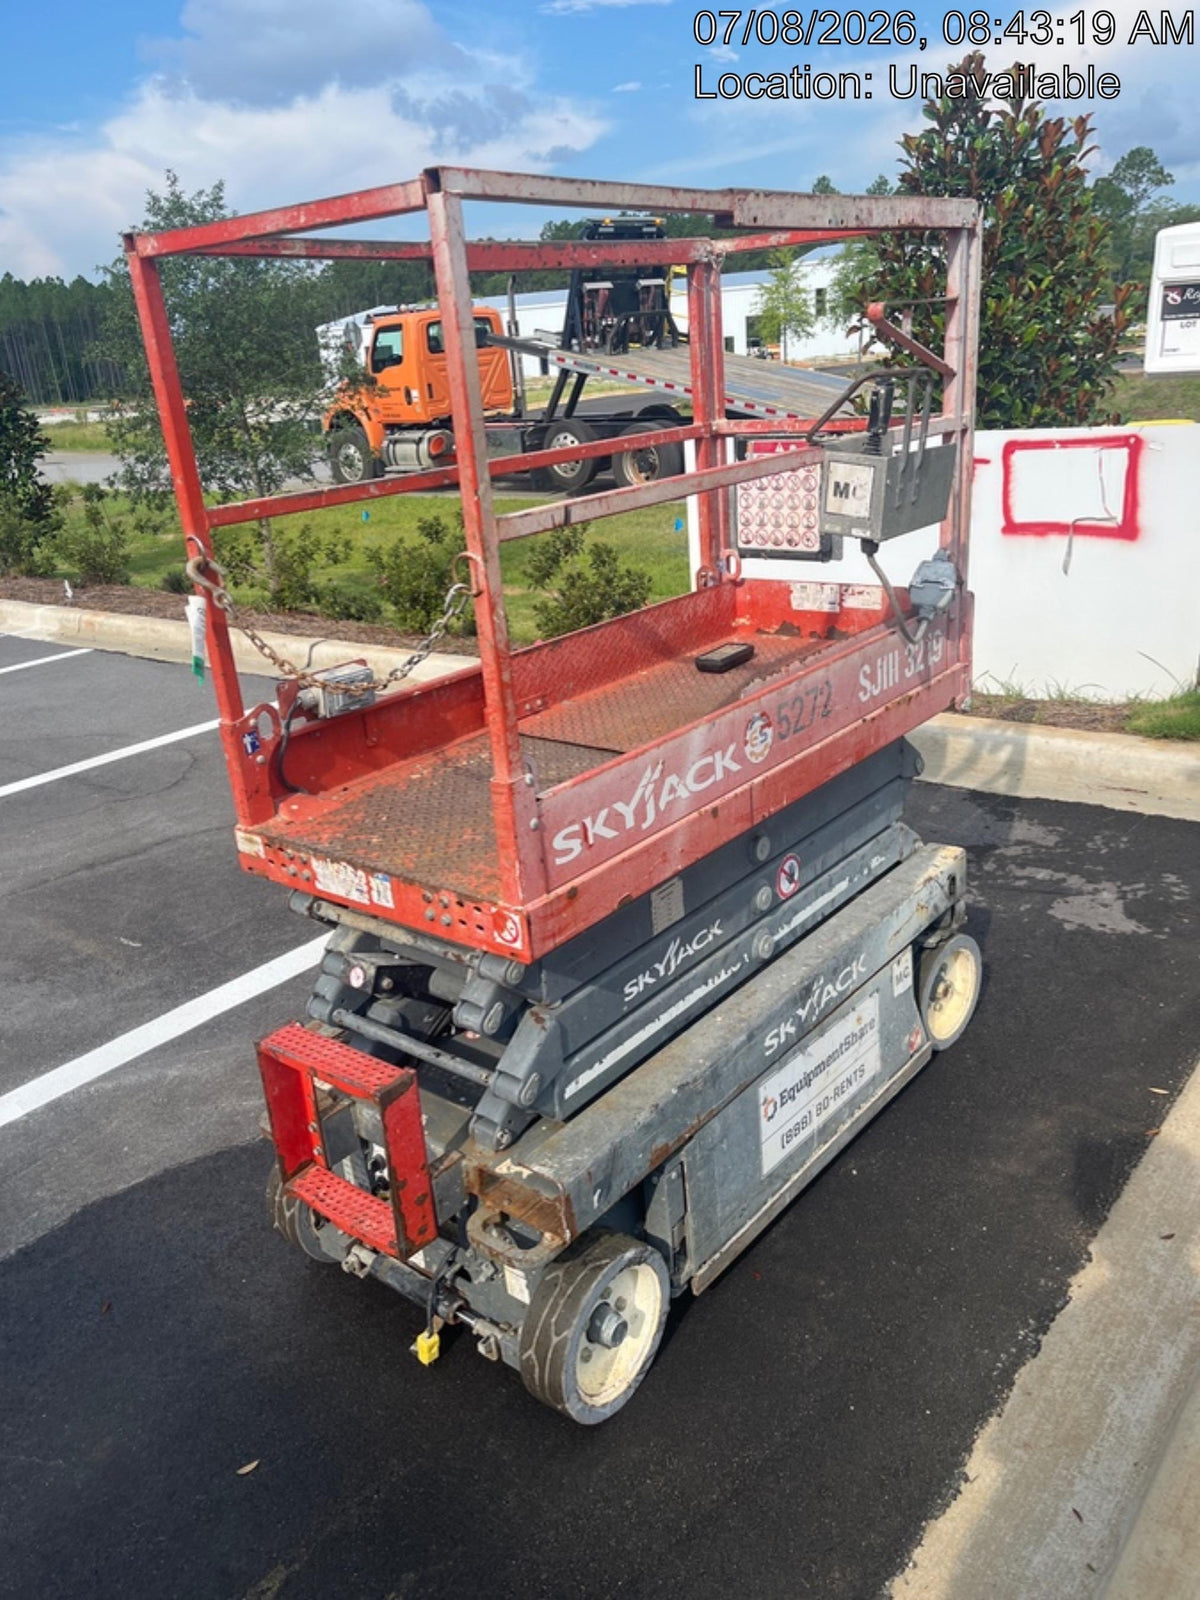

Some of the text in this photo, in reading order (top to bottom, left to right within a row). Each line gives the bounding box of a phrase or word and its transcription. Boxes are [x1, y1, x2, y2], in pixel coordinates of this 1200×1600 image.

[777, 680, 832, 741] 5272
[552, 742, 742, 865] SKYJACK
[623, 919, 723, 1002] SKYJACK
[763, 953, 867, 1056] SKYJACK
[779, 1017, 876, 1109] EquipmentShare
